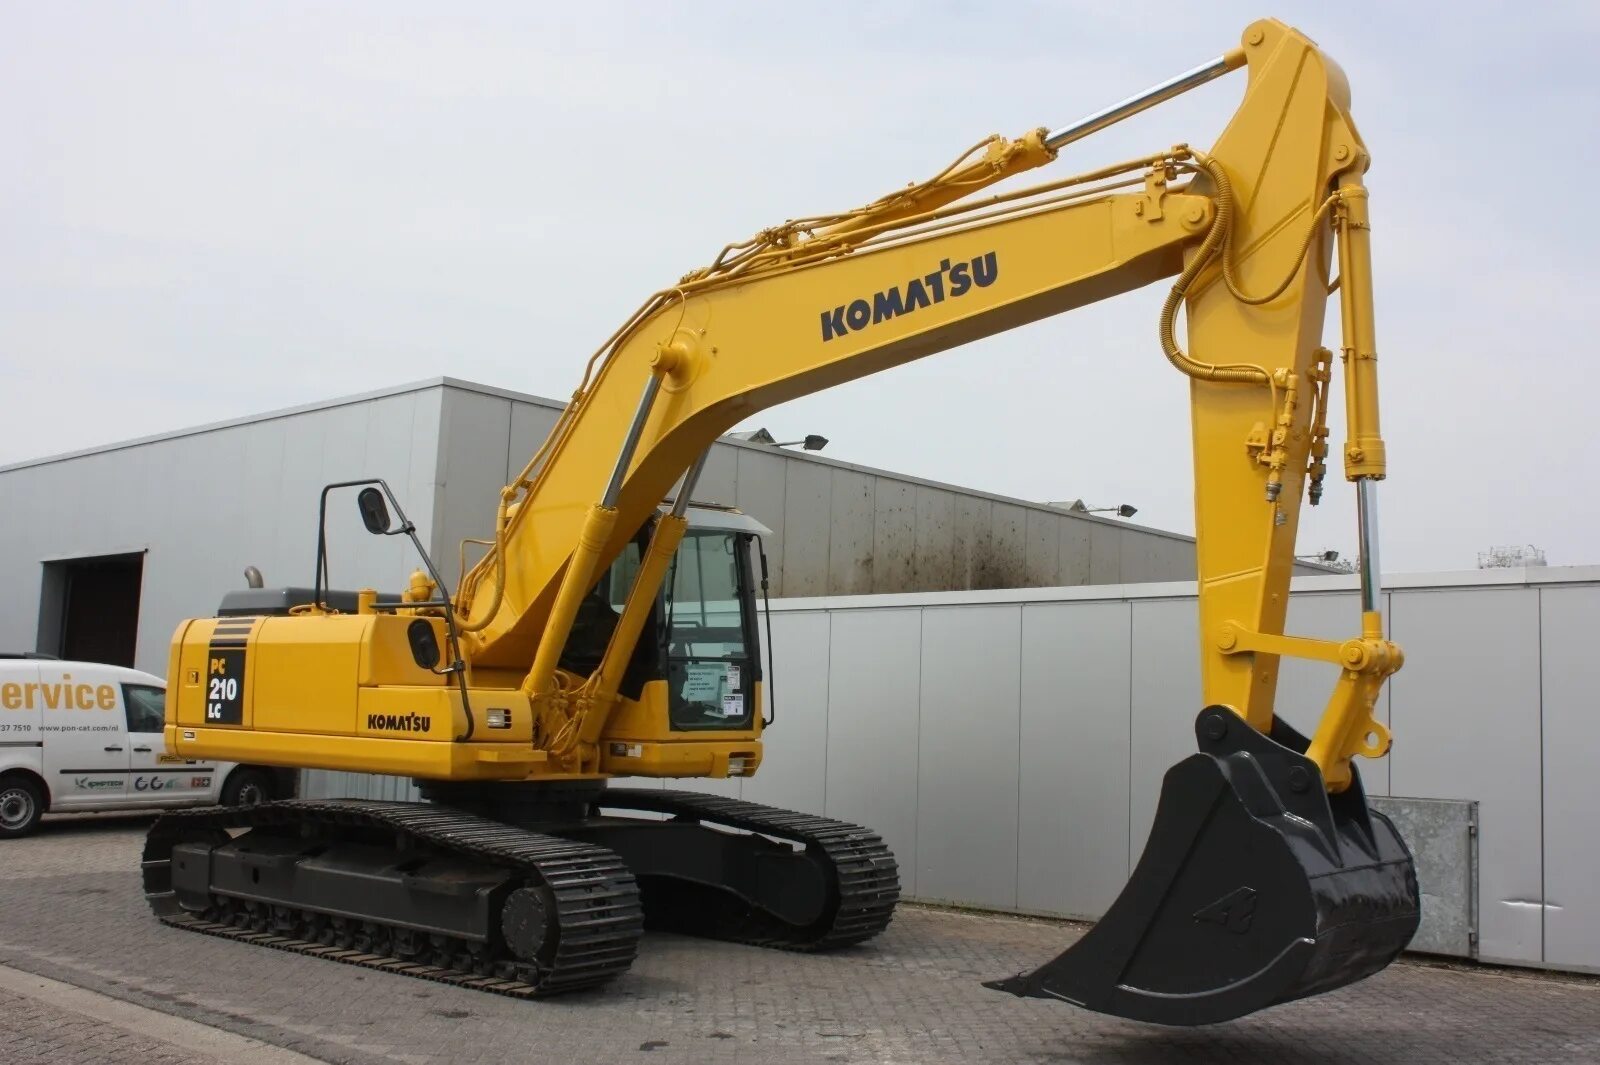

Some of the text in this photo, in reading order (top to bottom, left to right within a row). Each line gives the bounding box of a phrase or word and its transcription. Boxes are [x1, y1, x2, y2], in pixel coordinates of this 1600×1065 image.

[820, 251, 998, 342] KOMATSU
[210, 658, 226, 675] PC
[209, 678, 238, 701] 210
[207, 703, 222, 719] LC
[13, 724, 32, 732] 7510
[367, 711, 431, 733] KOMATSU
